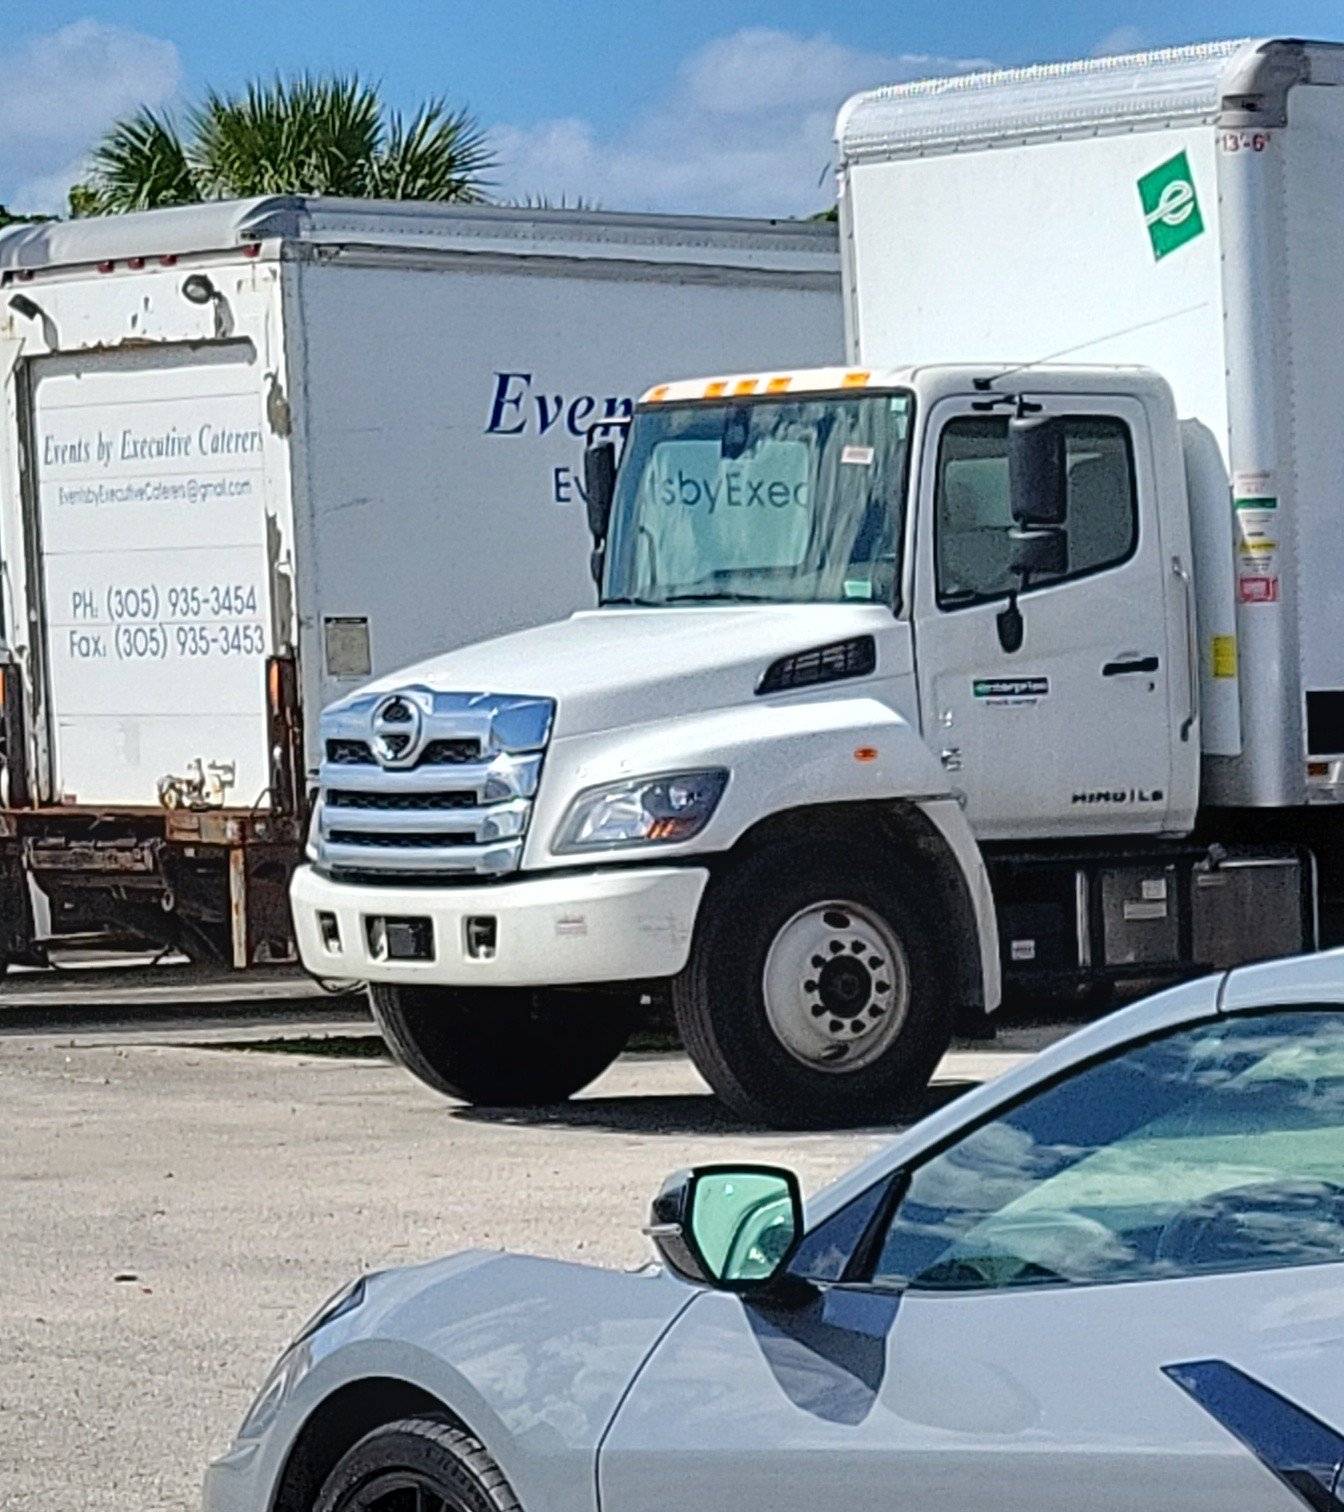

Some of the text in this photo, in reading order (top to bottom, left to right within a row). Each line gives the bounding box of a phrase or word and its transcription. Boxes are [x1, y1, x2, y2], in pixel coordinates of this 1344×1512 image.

[44, 423, 263, 467] Events by Executive Caterers
[106, 584, 159, 621] (305)
[168, 584, 257, 617] 935-3454
[115, 623, 168, 660] (305)
[176, 623, 265, 656] 935-3453
